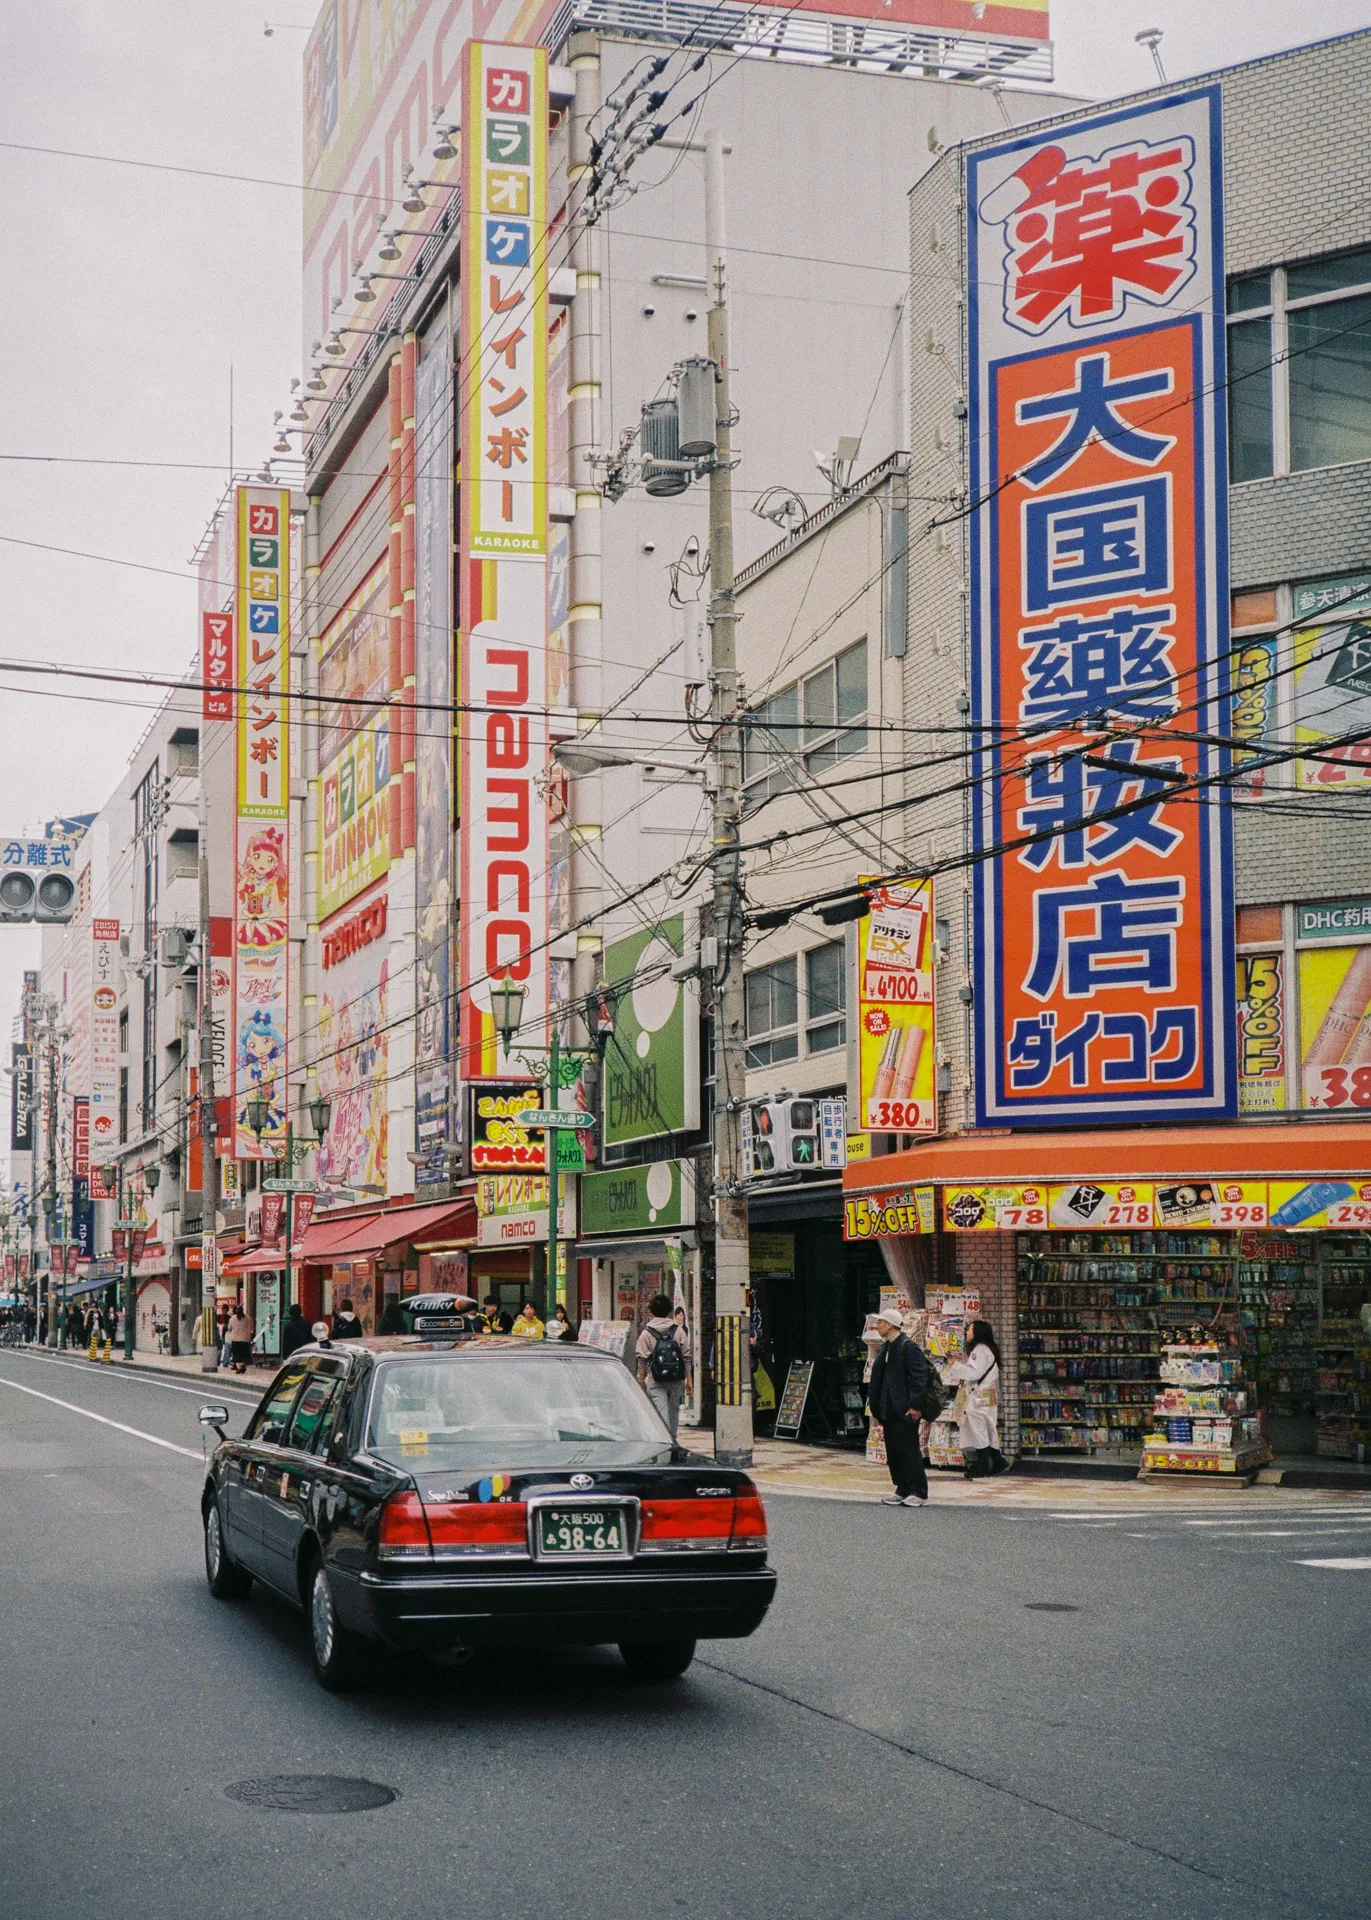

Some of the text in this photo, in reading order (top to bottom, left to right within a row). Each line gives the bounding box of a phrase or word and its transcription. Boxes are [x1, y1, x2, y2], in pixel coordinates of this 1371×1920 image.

[1014, 147, 1184, 325] 薬
[487, 73, 528, 520] カラオケレインボー
[474, 536, 540, 550] KARAOKE
[250, 507, 278, 798] カラオケレインボー
[325, 730, 389, 828] カラオケ
[242, 806, 286, 817] KARAOKE
[486, 649, 531, 981] namco
[324, 800, 389, 882] RAINBOW
[3, 842, 71, 867] 分離式
[338, 866, 371, 901] KARAOKE
[874, 924, 911, 940] アリナミン
[871, 935, 910, 955] EX
[98, 942, 110, 980] えびす
[869, 1012, 884, 1021] NOW
[870, 1024, 887, 1033] SALE!
[1008, 1004, 1199, 1089] ダイコク
[823, 1104, 834, 1139] 自転車
[833, 1104, 843, 1140] 歩行者
[870, 1103, 920, 1127] ¥380
[556, 1149, 583, 1164] タットハウス
[829, 1141, 839, 1165] 専用
[847, 1142, 864, 1153] ouse
[501, 1219, 536, 1239] namco
[846, 1198, 919, 1239] 15%OFF
[756, 1400, 772, 1408] use
[1146, 1454, 1217, 1469] 15%OFF
[560, 1513, 604, 1526] 大阪500
[546, 1533, 557, 1546] あ
[559, 1526, 620, 1551] 98-64
